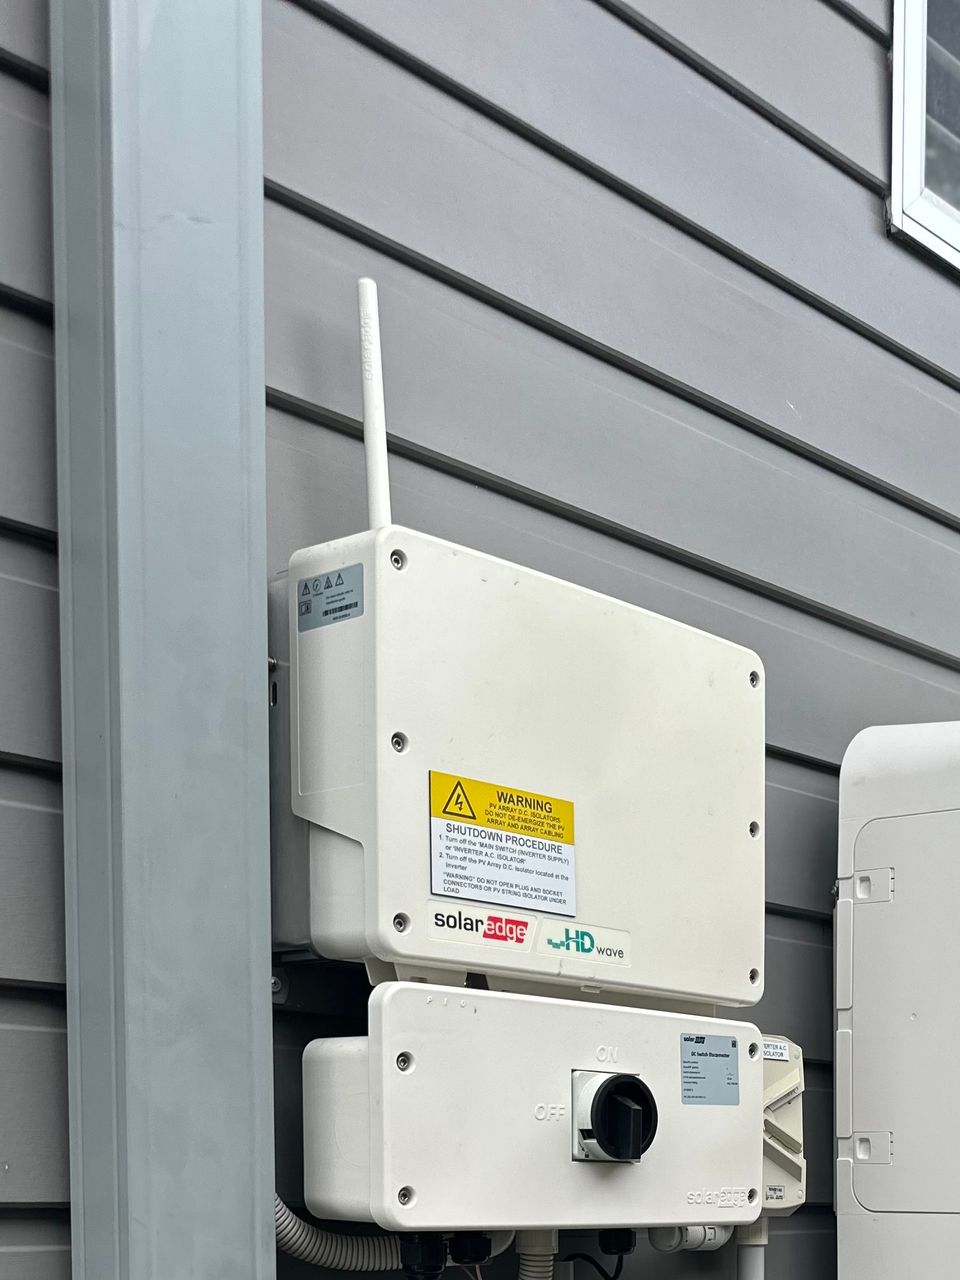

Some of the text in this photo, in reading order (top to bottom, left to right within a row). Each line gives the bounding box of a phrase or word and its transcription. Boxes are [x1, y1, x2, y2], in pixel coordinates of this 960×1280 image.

[496, 791, 553, 813] WARNING
[484, 809, 494, 817] DO
[545, 822, 557, 831] THE
[498, 804, 517, 813] ARRAY
[530, 811, 561, 823] ISOLATORS
[446, 822, 563, 855] SHUTDOWN PROCEDURE
[487, 818, 564, 839] ARRAY AND ARRAY CABLING
[445, 835, 458, 843] Turn
[495, 844, 517, 854] SWITCH
[518, 849, 546, 860] (INVERTER
[487, 860, 502, 870] Array
[535, 870, 554, 878] located
[443, 886, 460, 894] LOAD
[443, 878, 482, 890] CONNECTORS
[501, 888, 521, 897] STRING
[522, 892, 548, 901] ISOLATOR
[548, 896, 567, 905] UNDER
[498, 881, 514, 889] OPEN
[515, 883, 529, 892] PLUG
[542, 888, 563, 897] SOCKET
[434, 911, 529, 944] solaredge
[564, 928, 624, 959] HD wave
[595, 1045, 618, 1063] ON
[763, 1050, 784, 1058] SOLATOR
[534, 1103, 565, 1121] OFF
